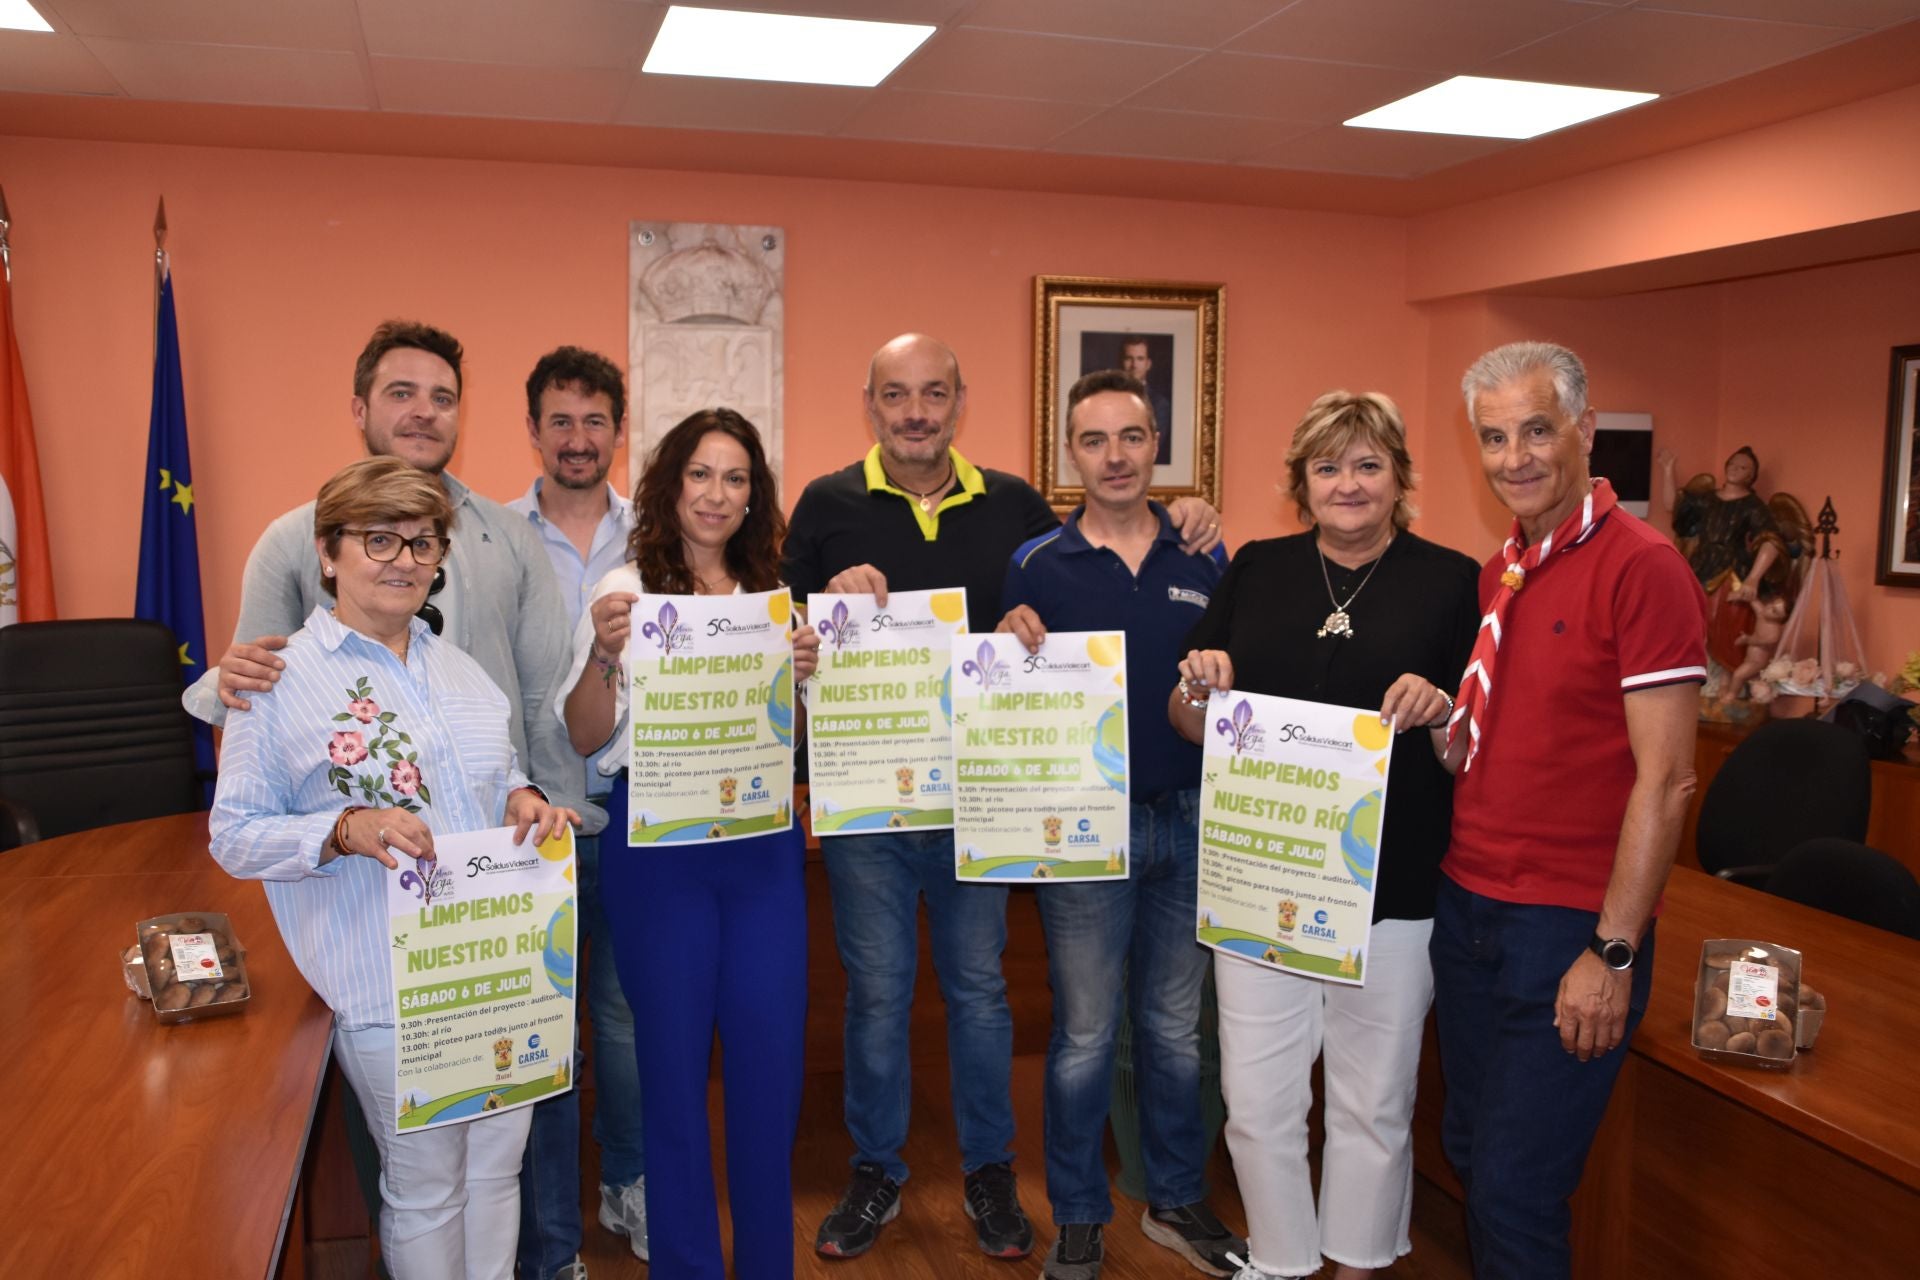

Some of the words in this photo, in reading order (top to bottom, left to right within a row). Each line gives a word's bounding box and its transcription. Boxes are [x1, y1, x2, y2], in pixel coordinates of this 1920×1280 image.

[659, 652, 763, 675] LIMPIEMOS
[832, 648, 930, 668] LIMPIEMOS
[644, 689, 738, 711] NUESTRO
[745, 681, 772, 706] RÍO
[820, 682, 907, 703] NUESTRO
[915, 675, 944, 698] RÍO
[979, 691, 1085, 712] LIMPIEMOS
[636, 726, 688, 741] SÁBADO
[692, 729, 700, 740] 6
[705, 728, 720, 739] DE
[725, 724, 756, 737] JULIO
[814, 717, 860, 732] SÁBADO
[866, 720, 872, 730] 6
[877, 718, 892, 729] DE
[897, 716, 928, 728] JULIO
[966, 727, 1058, 747] NUESTRO
[1066, 721, 1097, 745] RÍO
[720, 746, 750, 756] proyecto
[664, 770, 692, 778] picoteo
[734, 766, 751, 774] junto
[959, 762, 1009, 776] SÁBADO
[1025, 764, 1042, 775] DE
[1046, 763, 1080, 775] JULIO
[1229, 755, 1340, 792] LIMPIEMOS
[634, 780, 671, 788] municipal
[920, 783, 952, 793] CARSAL
[742, 790, 770, 802] CARSAL
[958, 816, 994, 824] municipal
[1016, 806, 1032, 814] para
[1213, 790, 1307, 825] NUESTRO
[1314, 804, 1350, 833] RÍO
[1068, 834, 1100, 844] CARSAL
[1204, 824, 1252, 848] SÁBADO
[1256, 838, 1264, 850] 6
[1268, 840, 1284, 854] DE
[1288, 844, 1324, 862] JULIO
[467, 856, 492, 878] 50
[1282, 867, 1316, 879] proyecto
[1322, 874, 1359, 886] auditorio
[1252, 882, 1270, 891] para
[1296, 890, 1316, 900] junto
[1328, 896, 1358, 908] frontón
[420, 892, 534, 929] LIMPIEMOS
[1302, 924, 1337, 940] CARSAL
[407, 936, 508, 974] NUESTRO
[516, 924, 549, 955] RÍO
[402, 990, 457, 1010] SÁBADO
[462, 986, 470, 1000] 6
[474, 982, 492, 997] DE
[496, 974, 531, 993] JULIO
[400, 1019, 422, 1030] 9.30h
[480, 1006, 491, 1016] del
[492, 1000, 526, 1014] proyecto
[530, 992, 564, 1006] auditorio
[401, 1042, 430, 1053] 13.00h:
[434, 1035, 463, 1049] picoteo
[464, 1031, 482, 1042] para
[484, 1026, 507, 1037] tod@s
[508, 1023, 528, 1034] junto
[530, 1018, 536, 1028] al
[537, 1012, 564, 1025] frontón
[401, 1031, 430, 1042] 10.30h:
[432, 1028, 439, 1036] al
[440, 1026, 452, 1034] río
[398, 1068, 414, 1078] Con
[416, 1066, 422, 1074] la
[424, 1055, 471, 1073] colaboración
[401, 1051, 442, 1065] municipal
[518, 1048, 550, 1065] CARSAL
